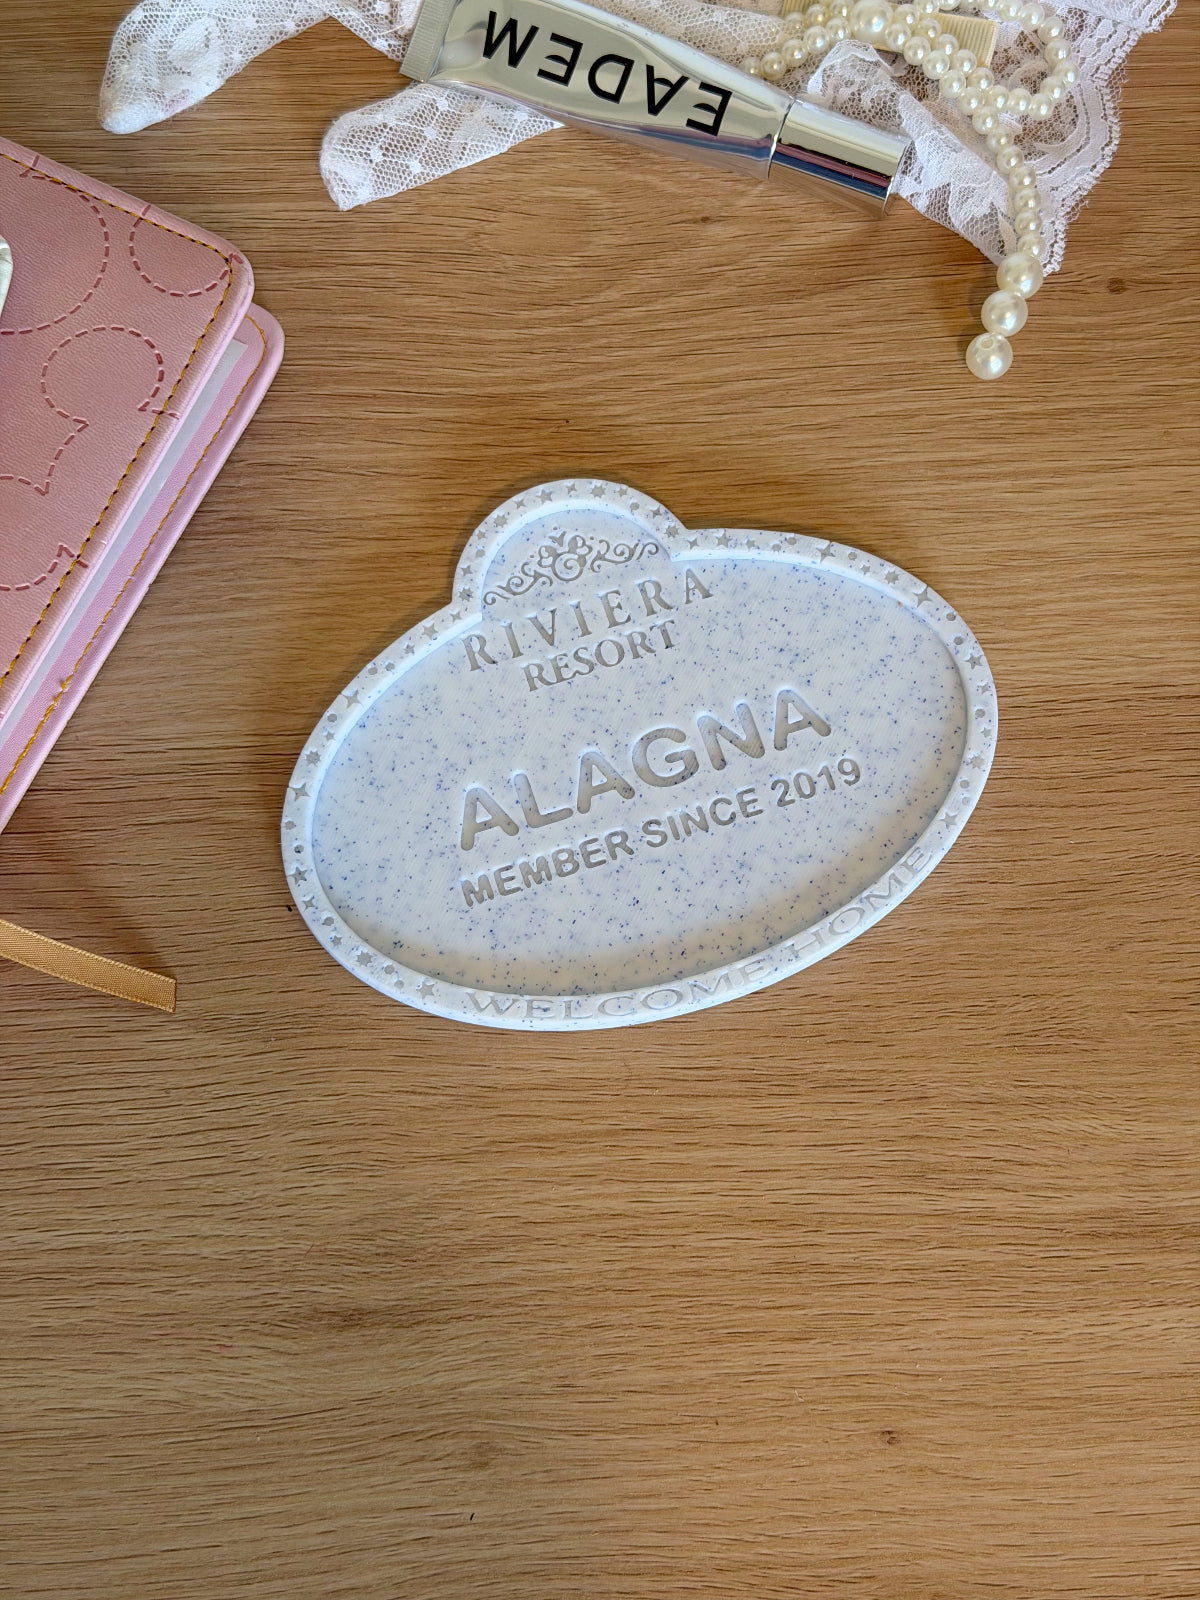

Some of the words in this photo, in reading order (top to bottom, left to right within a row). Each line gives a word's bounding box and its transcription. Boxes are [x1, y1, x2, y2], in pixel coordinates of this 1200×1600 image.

[482, 11, 733, 136] EADEM
[462, 568, 714, 671] RIVIERA
[521, 620, 675, 691] RESORT
[460, 688, 831, 851] ALAGNA
[460, 830, 634, 907] MEMBER
[642, 787, 763, 848] SINCE
[771, 758, 861, 808] 2019
[465, 957, 777, 1020] WELCOME
[787, 850, 934, 962] HOME
